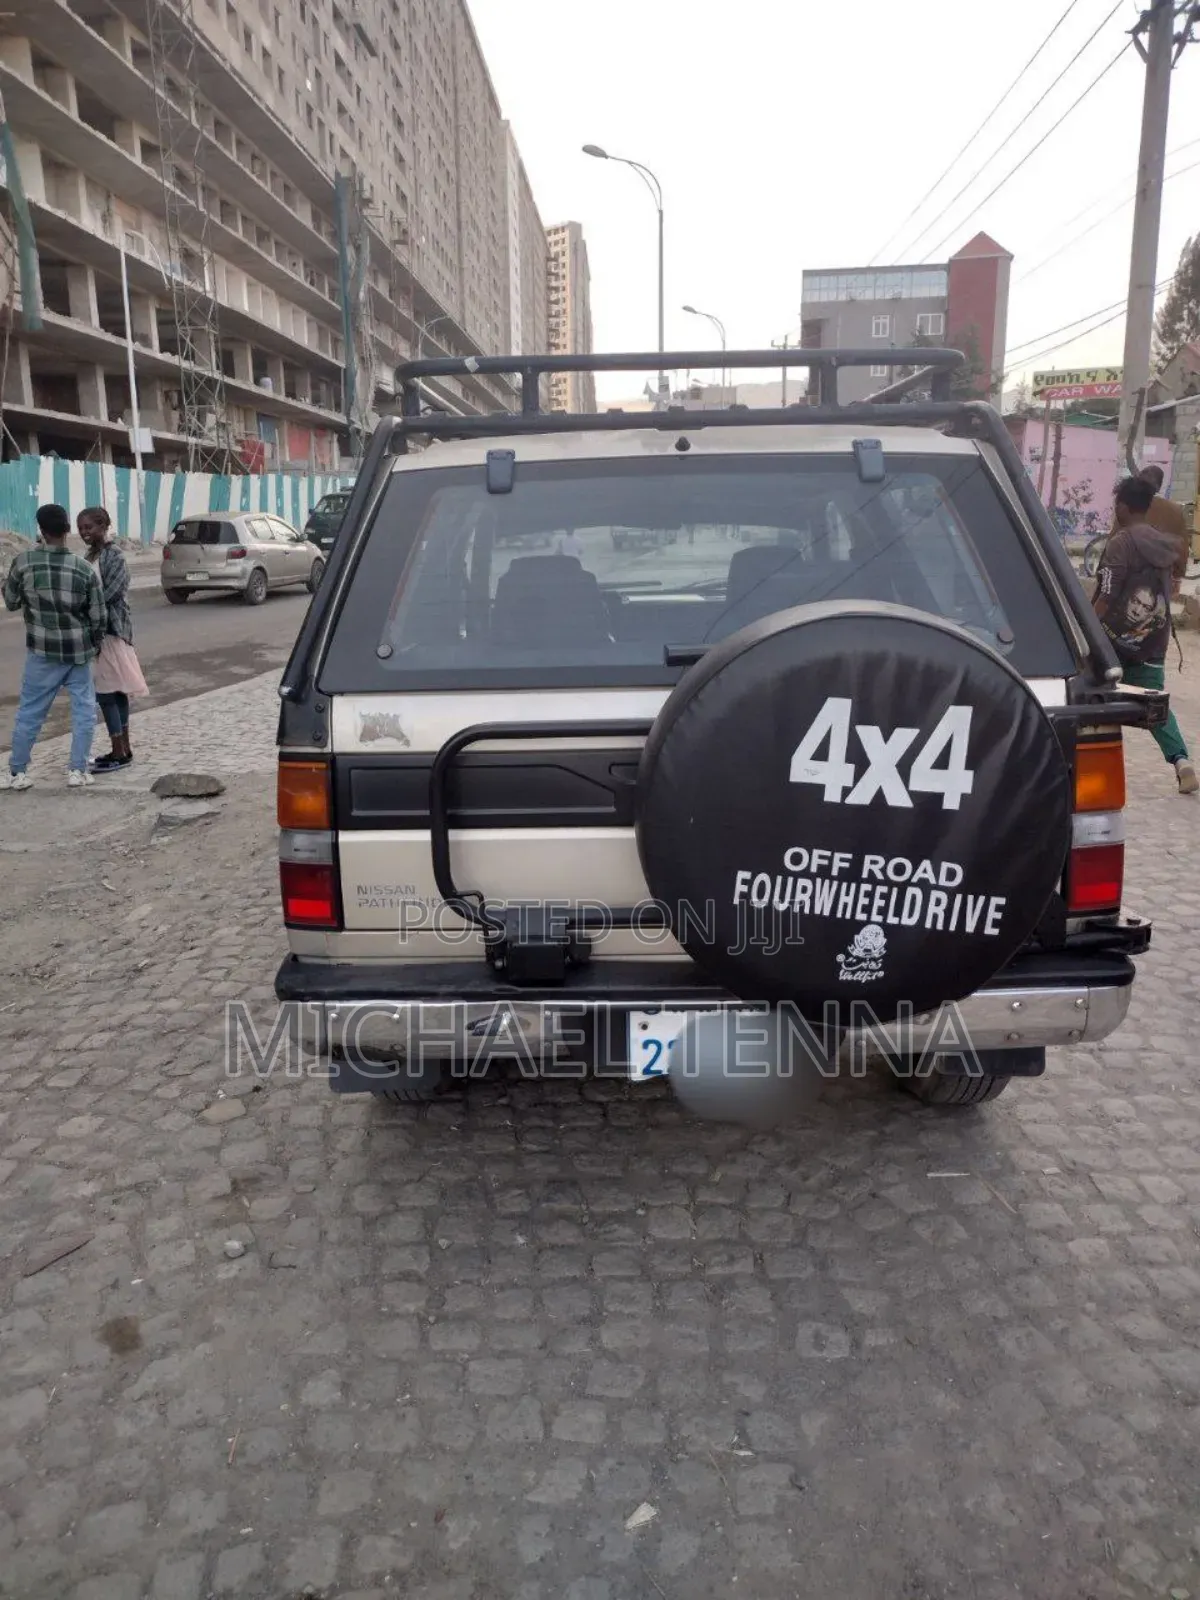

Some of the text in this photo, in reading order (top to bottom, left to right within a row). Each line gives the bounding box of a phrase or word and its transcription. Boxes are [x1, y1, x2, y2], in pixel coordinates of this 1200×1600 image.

[1047, 384, 1123, 397] CAR WA
[789, 697, 974, 810] 4x4
[783, 846, 964, 888] OFF ROAD
[356, 884, 416, 896] NISSAN
[733, 870, 1006, 936] FOURWHEELDRIVE
